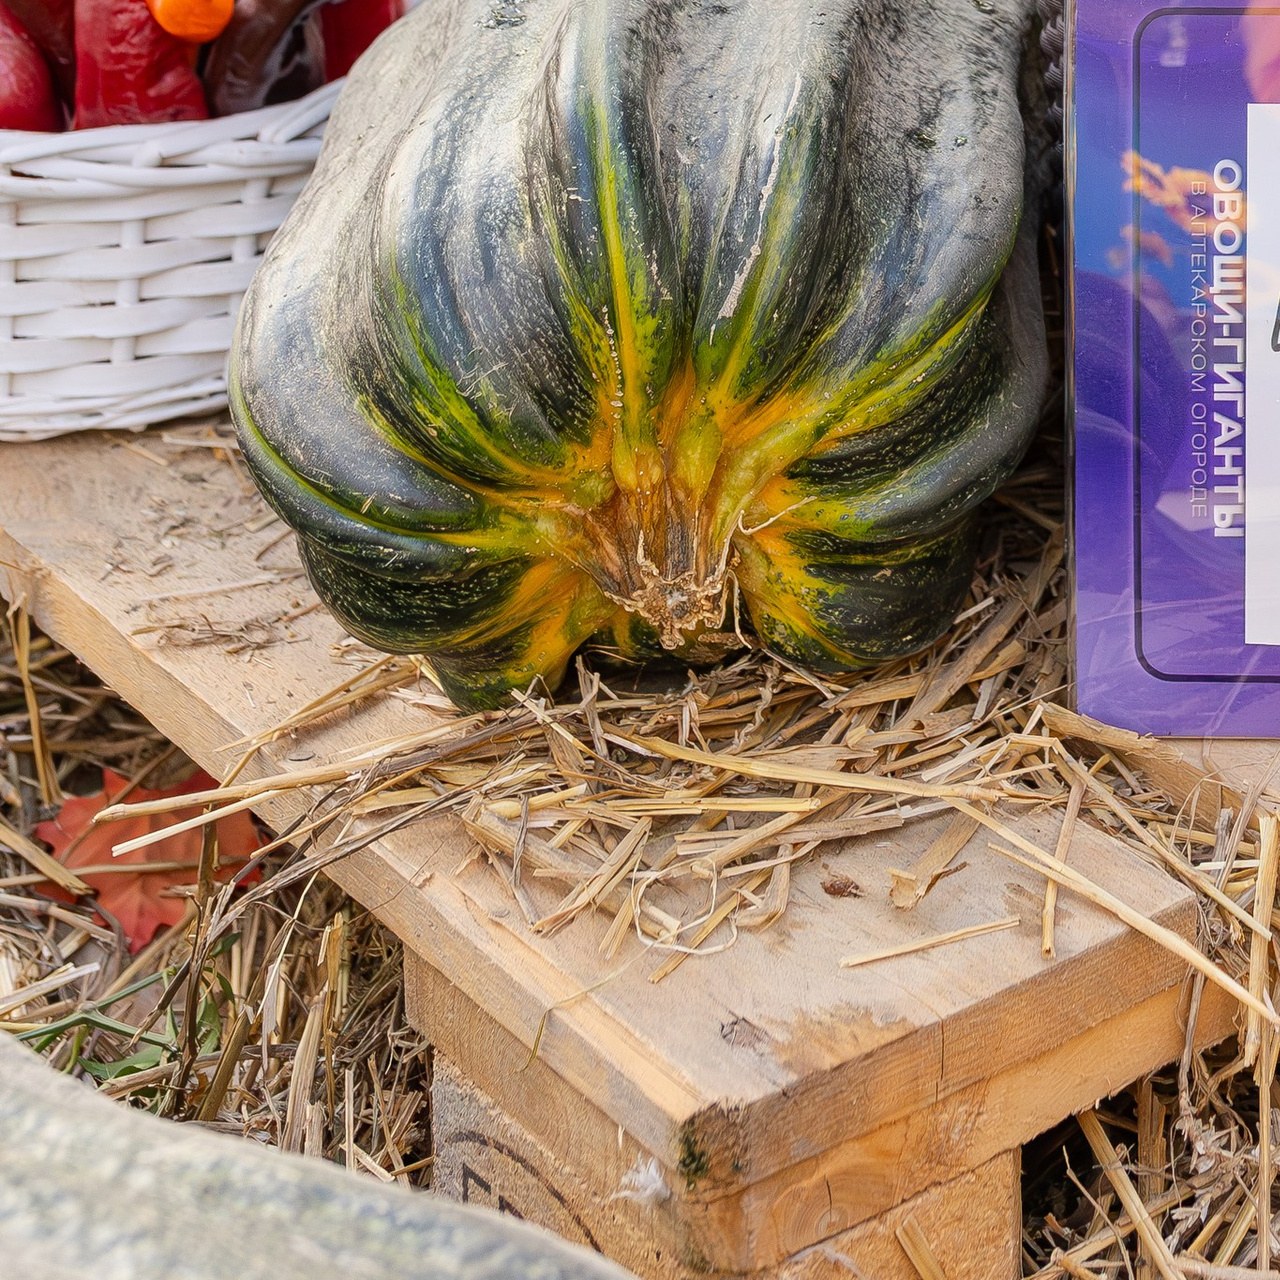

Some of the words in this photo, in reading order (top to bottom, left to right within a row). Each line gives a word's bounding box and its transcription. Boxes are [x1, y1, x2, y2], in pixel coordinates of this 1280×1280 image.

[1190, 180, 1207, 195] В
[1190, 203, 1207, 393] АПТЕКАРСКОМ
[1210, 158, 1245, 538] ОВОЩИ-ГИГАНТЫ
[1189, 402, 1207, 518] ОГОРОДЕ
